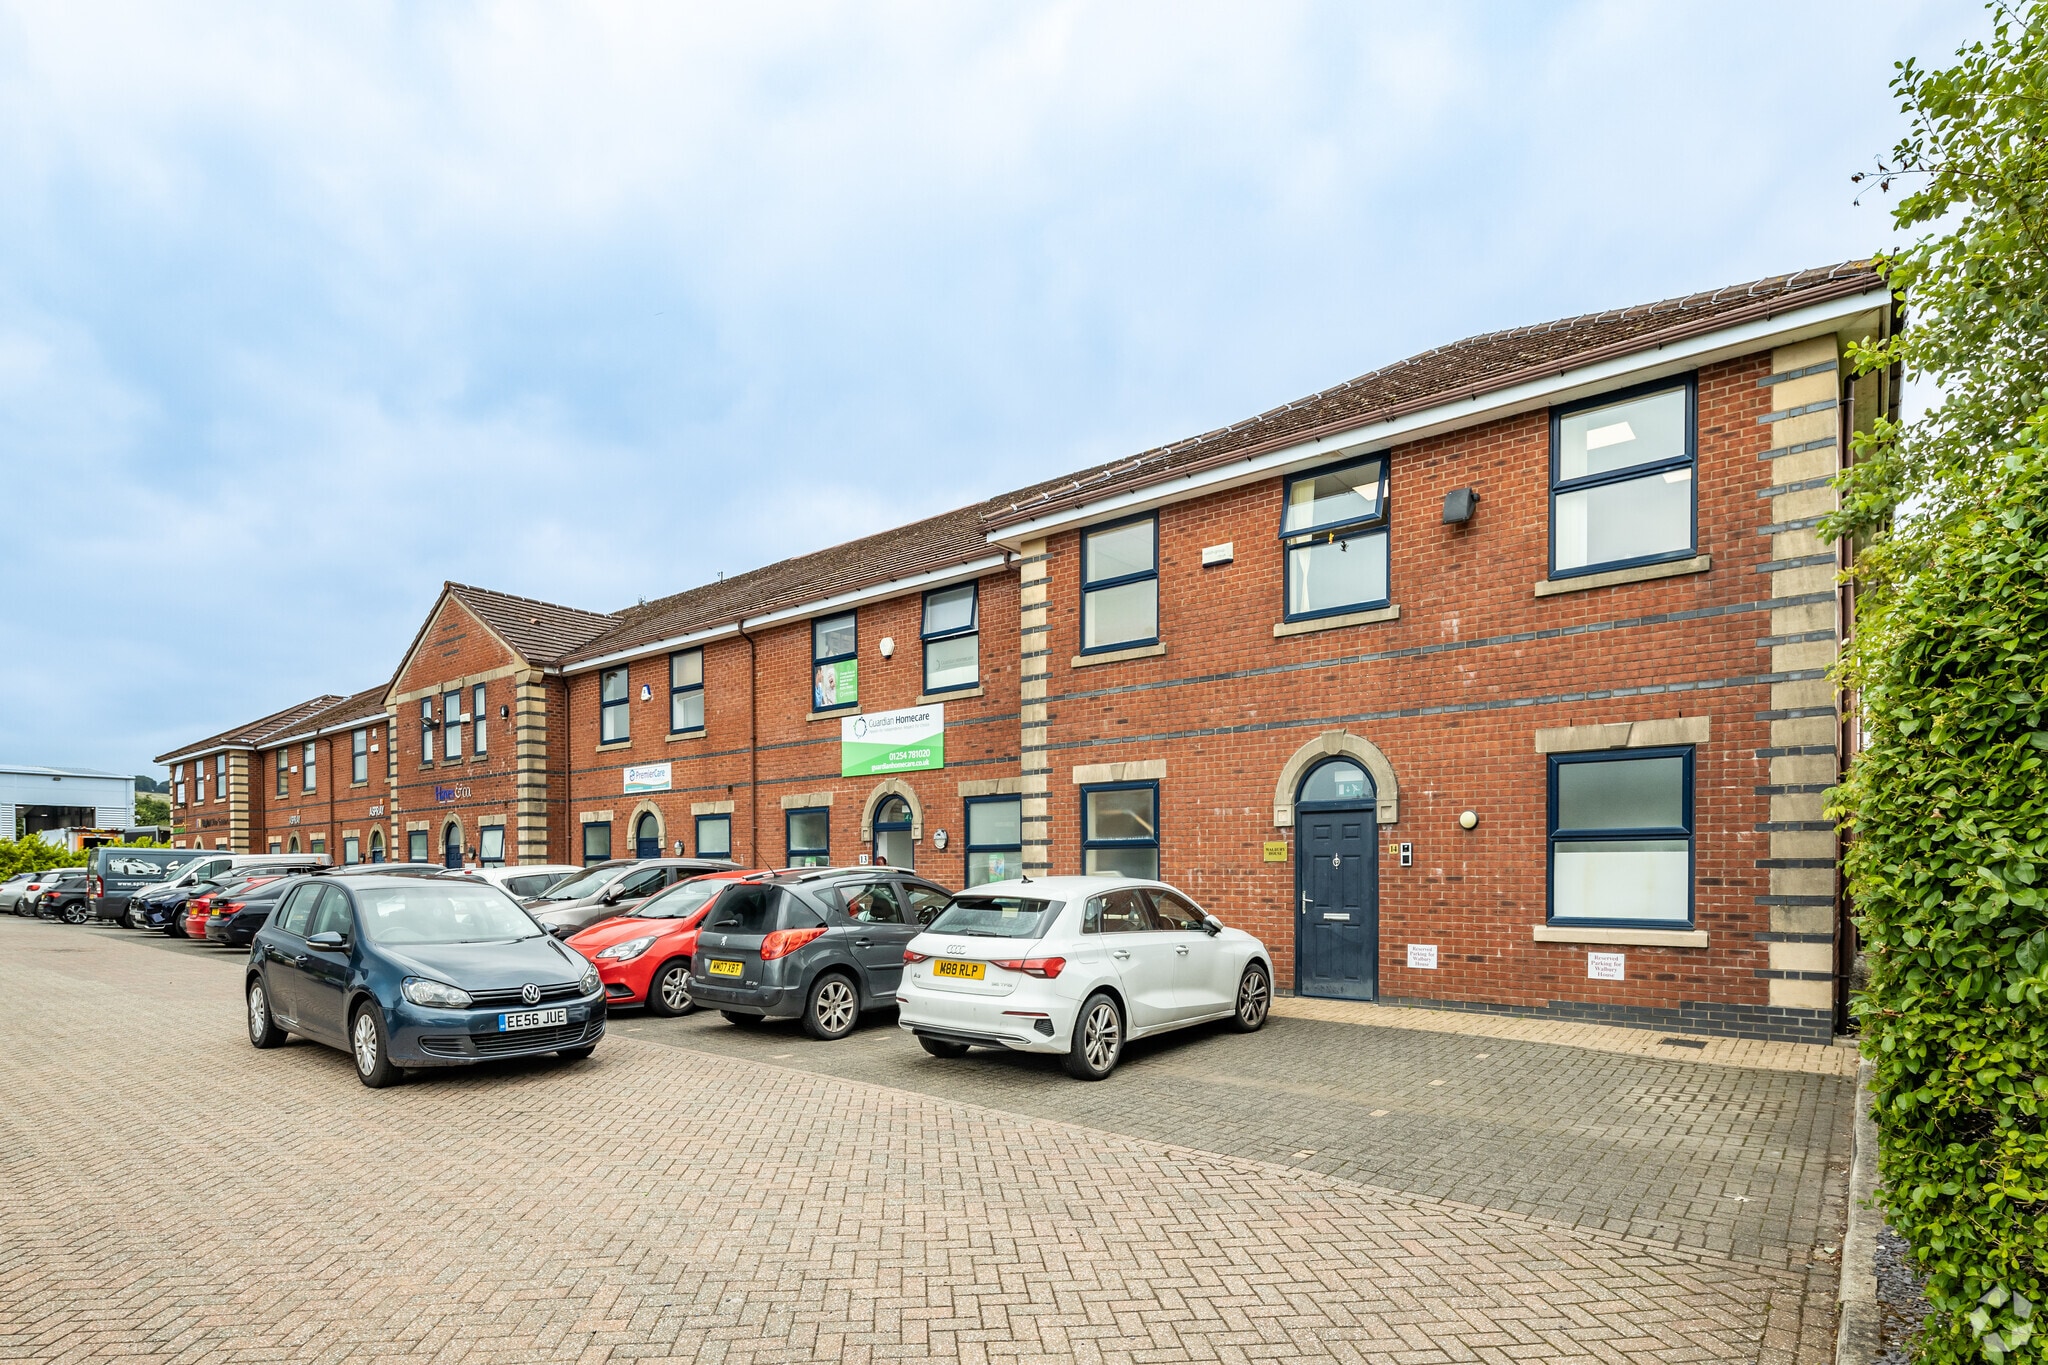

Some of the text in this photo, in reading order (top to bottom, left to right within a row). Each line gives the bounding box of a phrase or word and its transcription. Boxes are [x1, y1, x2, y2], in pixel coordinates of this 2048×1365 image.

[868, 716, 894, 728] Guardian
[895, 713, 930, 724] Homecare
[889, 749, 930, 761] 01254 781020
[871, 759, 930, 772] guardianhomecare.co.uk
[635, 769, 666, 779] PremierCare
[860, 855, 868, 864] 13
[940, 962, 978, 976] M88 RLP
[507, 1010, 564, 1028] EE56 JUE
